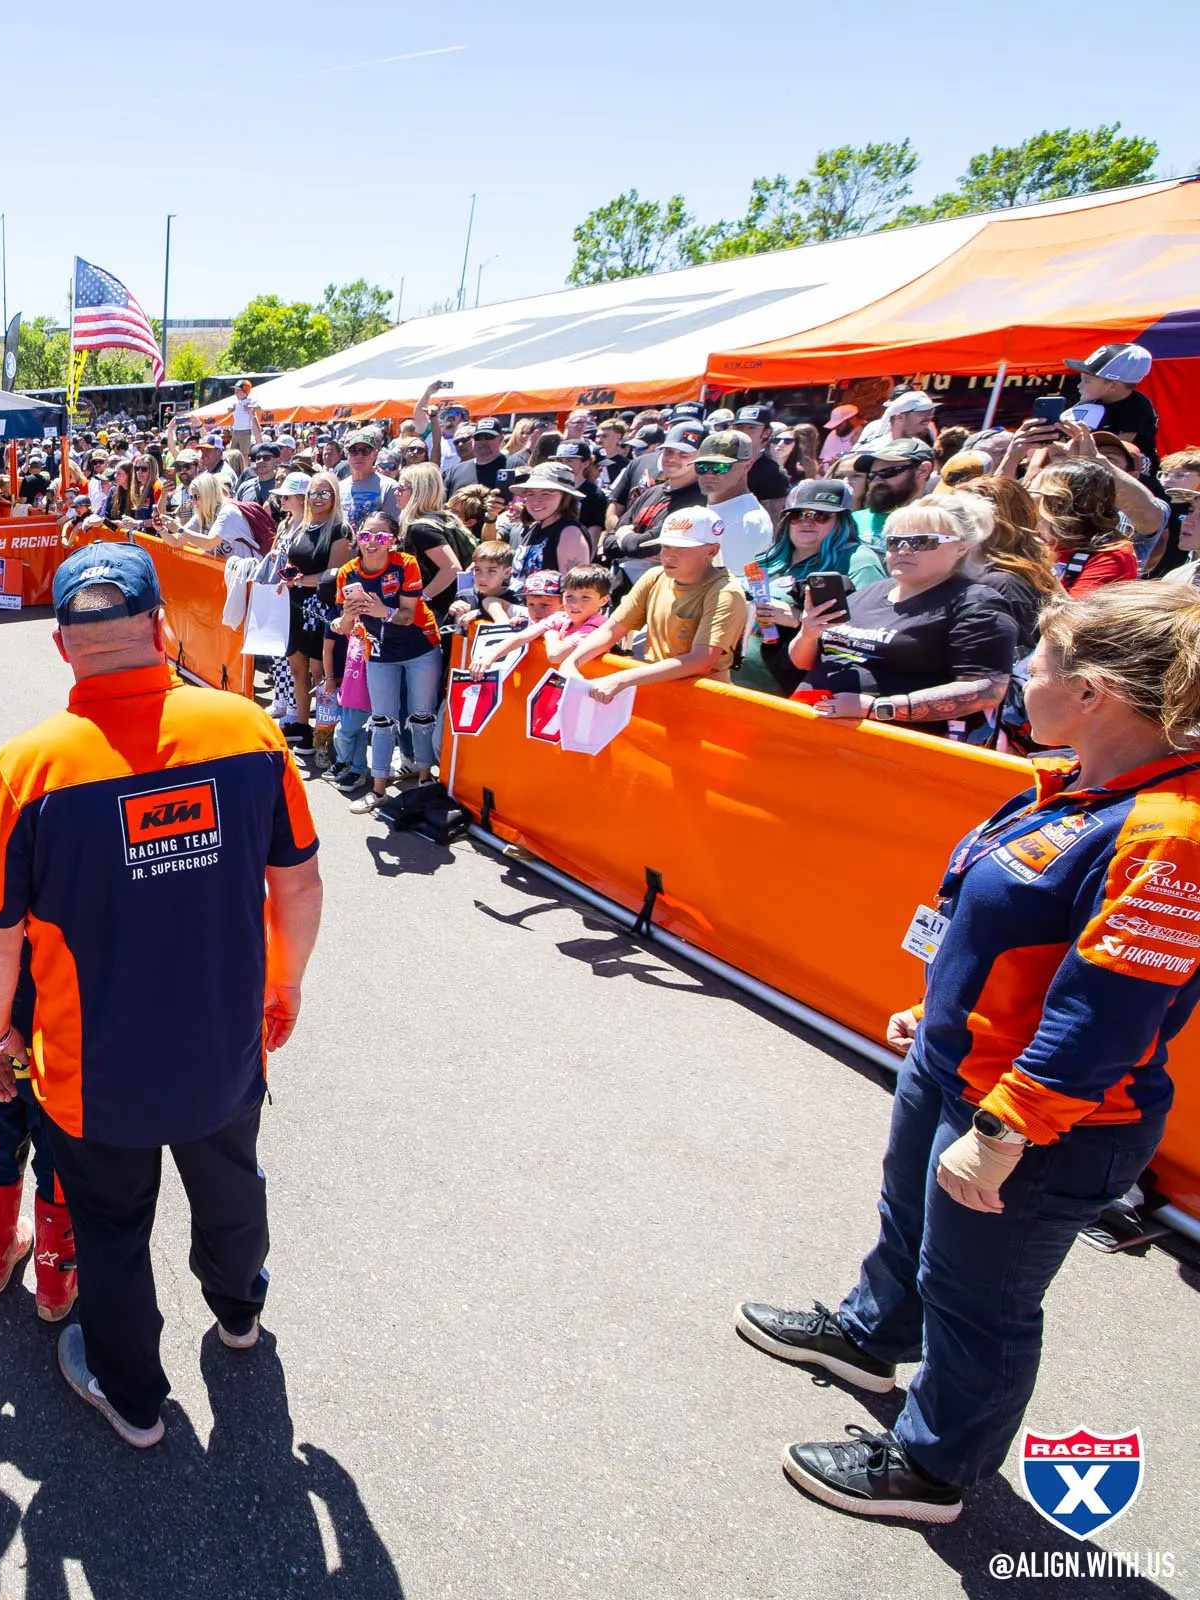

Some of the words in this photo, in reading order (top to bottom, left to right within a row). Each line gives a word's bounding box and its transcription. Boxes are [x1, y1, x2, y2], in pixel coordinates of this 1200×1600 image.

[576, 387, 616, 406] KTM
[79, 566, 110, 580] KTM
[318, 707, 330, 715] ELI
[458, 684, 482, 727] 1
[318, 713, 341, 723] TOMA
[139, 801, 202, 831] KTM
[129, 840, 178, 859] RACING
[184, 831, 219, 849] TEAM
[1016, 838, 1047, 861] KTM
[131, 866, 148, 881] JR.
[151, 853, 219, 873] SUPERCROSS
[1008, 859, 1037, 880] RACING
[1125, 856, 1200, 893] PARAD
[1144, 884, 1185, 897] CHEVROLET
[930, 919, 944, 935] L1
[1140, 923, 1200, 943] RENTHA
